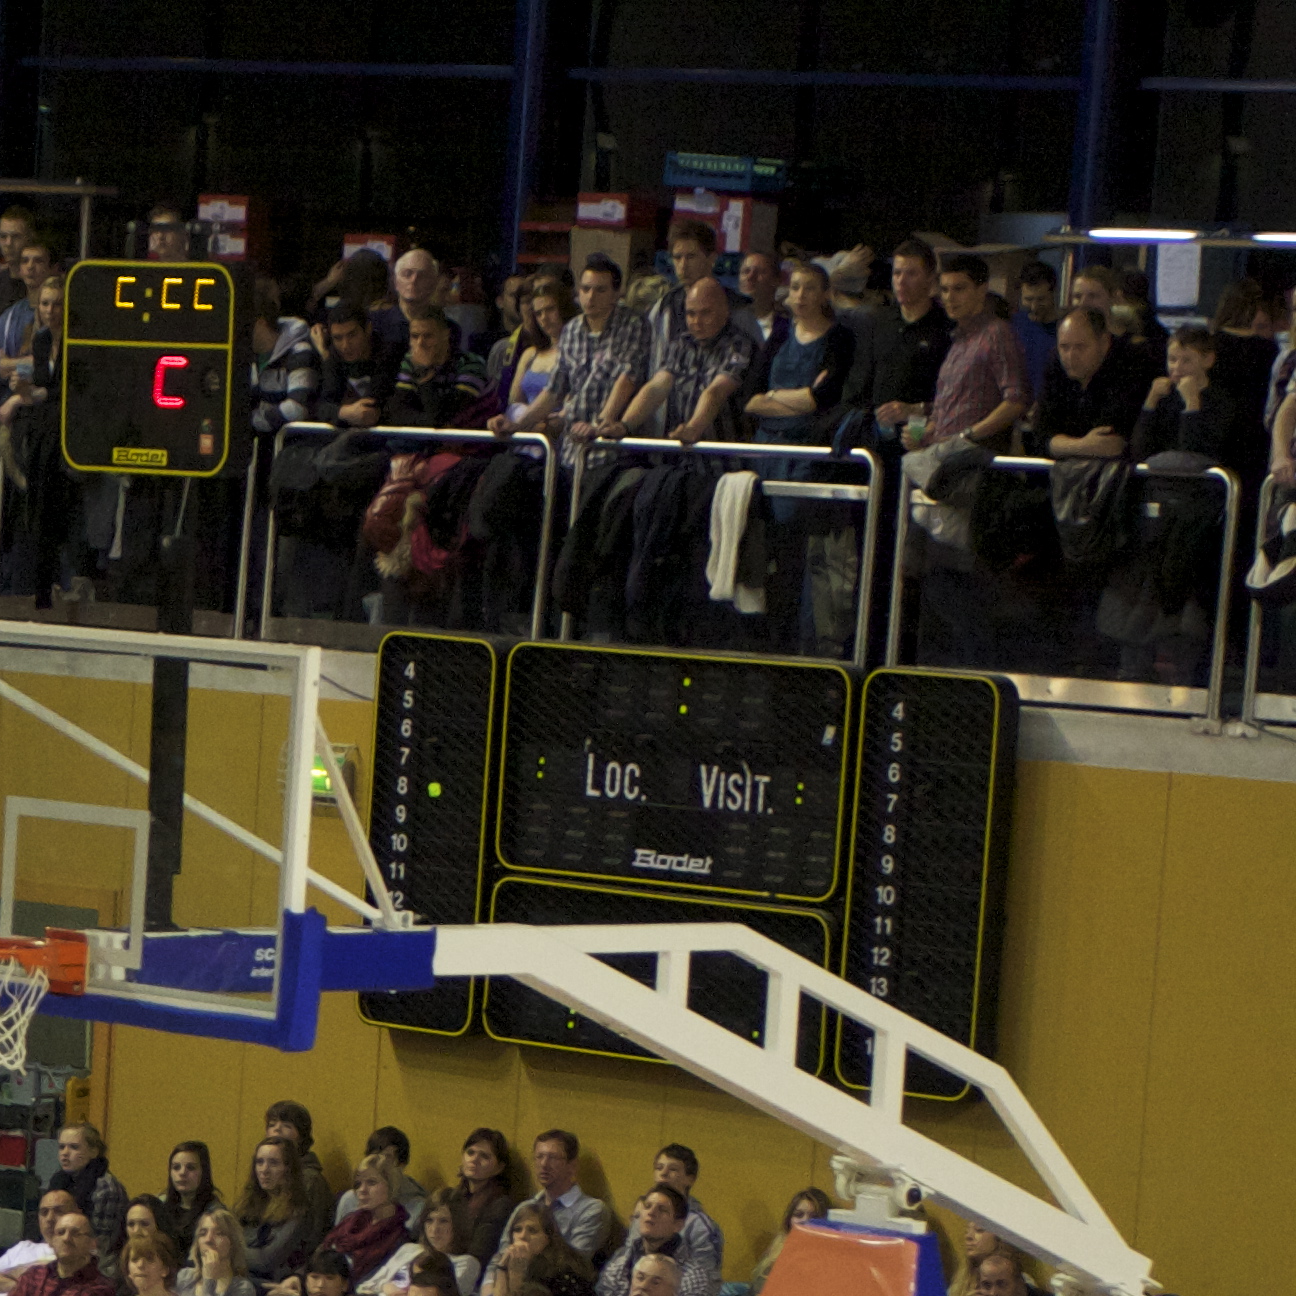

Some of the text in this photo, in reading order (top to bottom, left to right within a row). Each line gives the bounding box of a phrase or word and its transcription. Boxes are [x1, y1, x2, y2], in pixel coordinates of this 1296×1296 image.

[403, 661, 416, 679] 4
[402, 690, 414, 709] 5
[891, 702, 904, 722] 4
[400, 719, 412, 737] 6
[890, 732, 903, 752] 5
[399, 747, 410, 765] 7
[887, 762, 900, 783] 6
[396, 776, 408, 794] 8
[585, 754, 774, 815] LOC. VISIT.
[887, 793, 898, 813] 7
[395, 805, 406, 823] 9
[391, 833, 408, 852] 10
[883, 824, 896, 844] 8
[389, 862, 405, 880] 11
[633, 848, 713, 875] Bodet
[881, 854, 894, 875] 9
[875, 885, 895, 906] 10
[874, 916, 893, 936] 11
[871, 947, 890, 967] 12
[870, 977, 888, 997] 13
